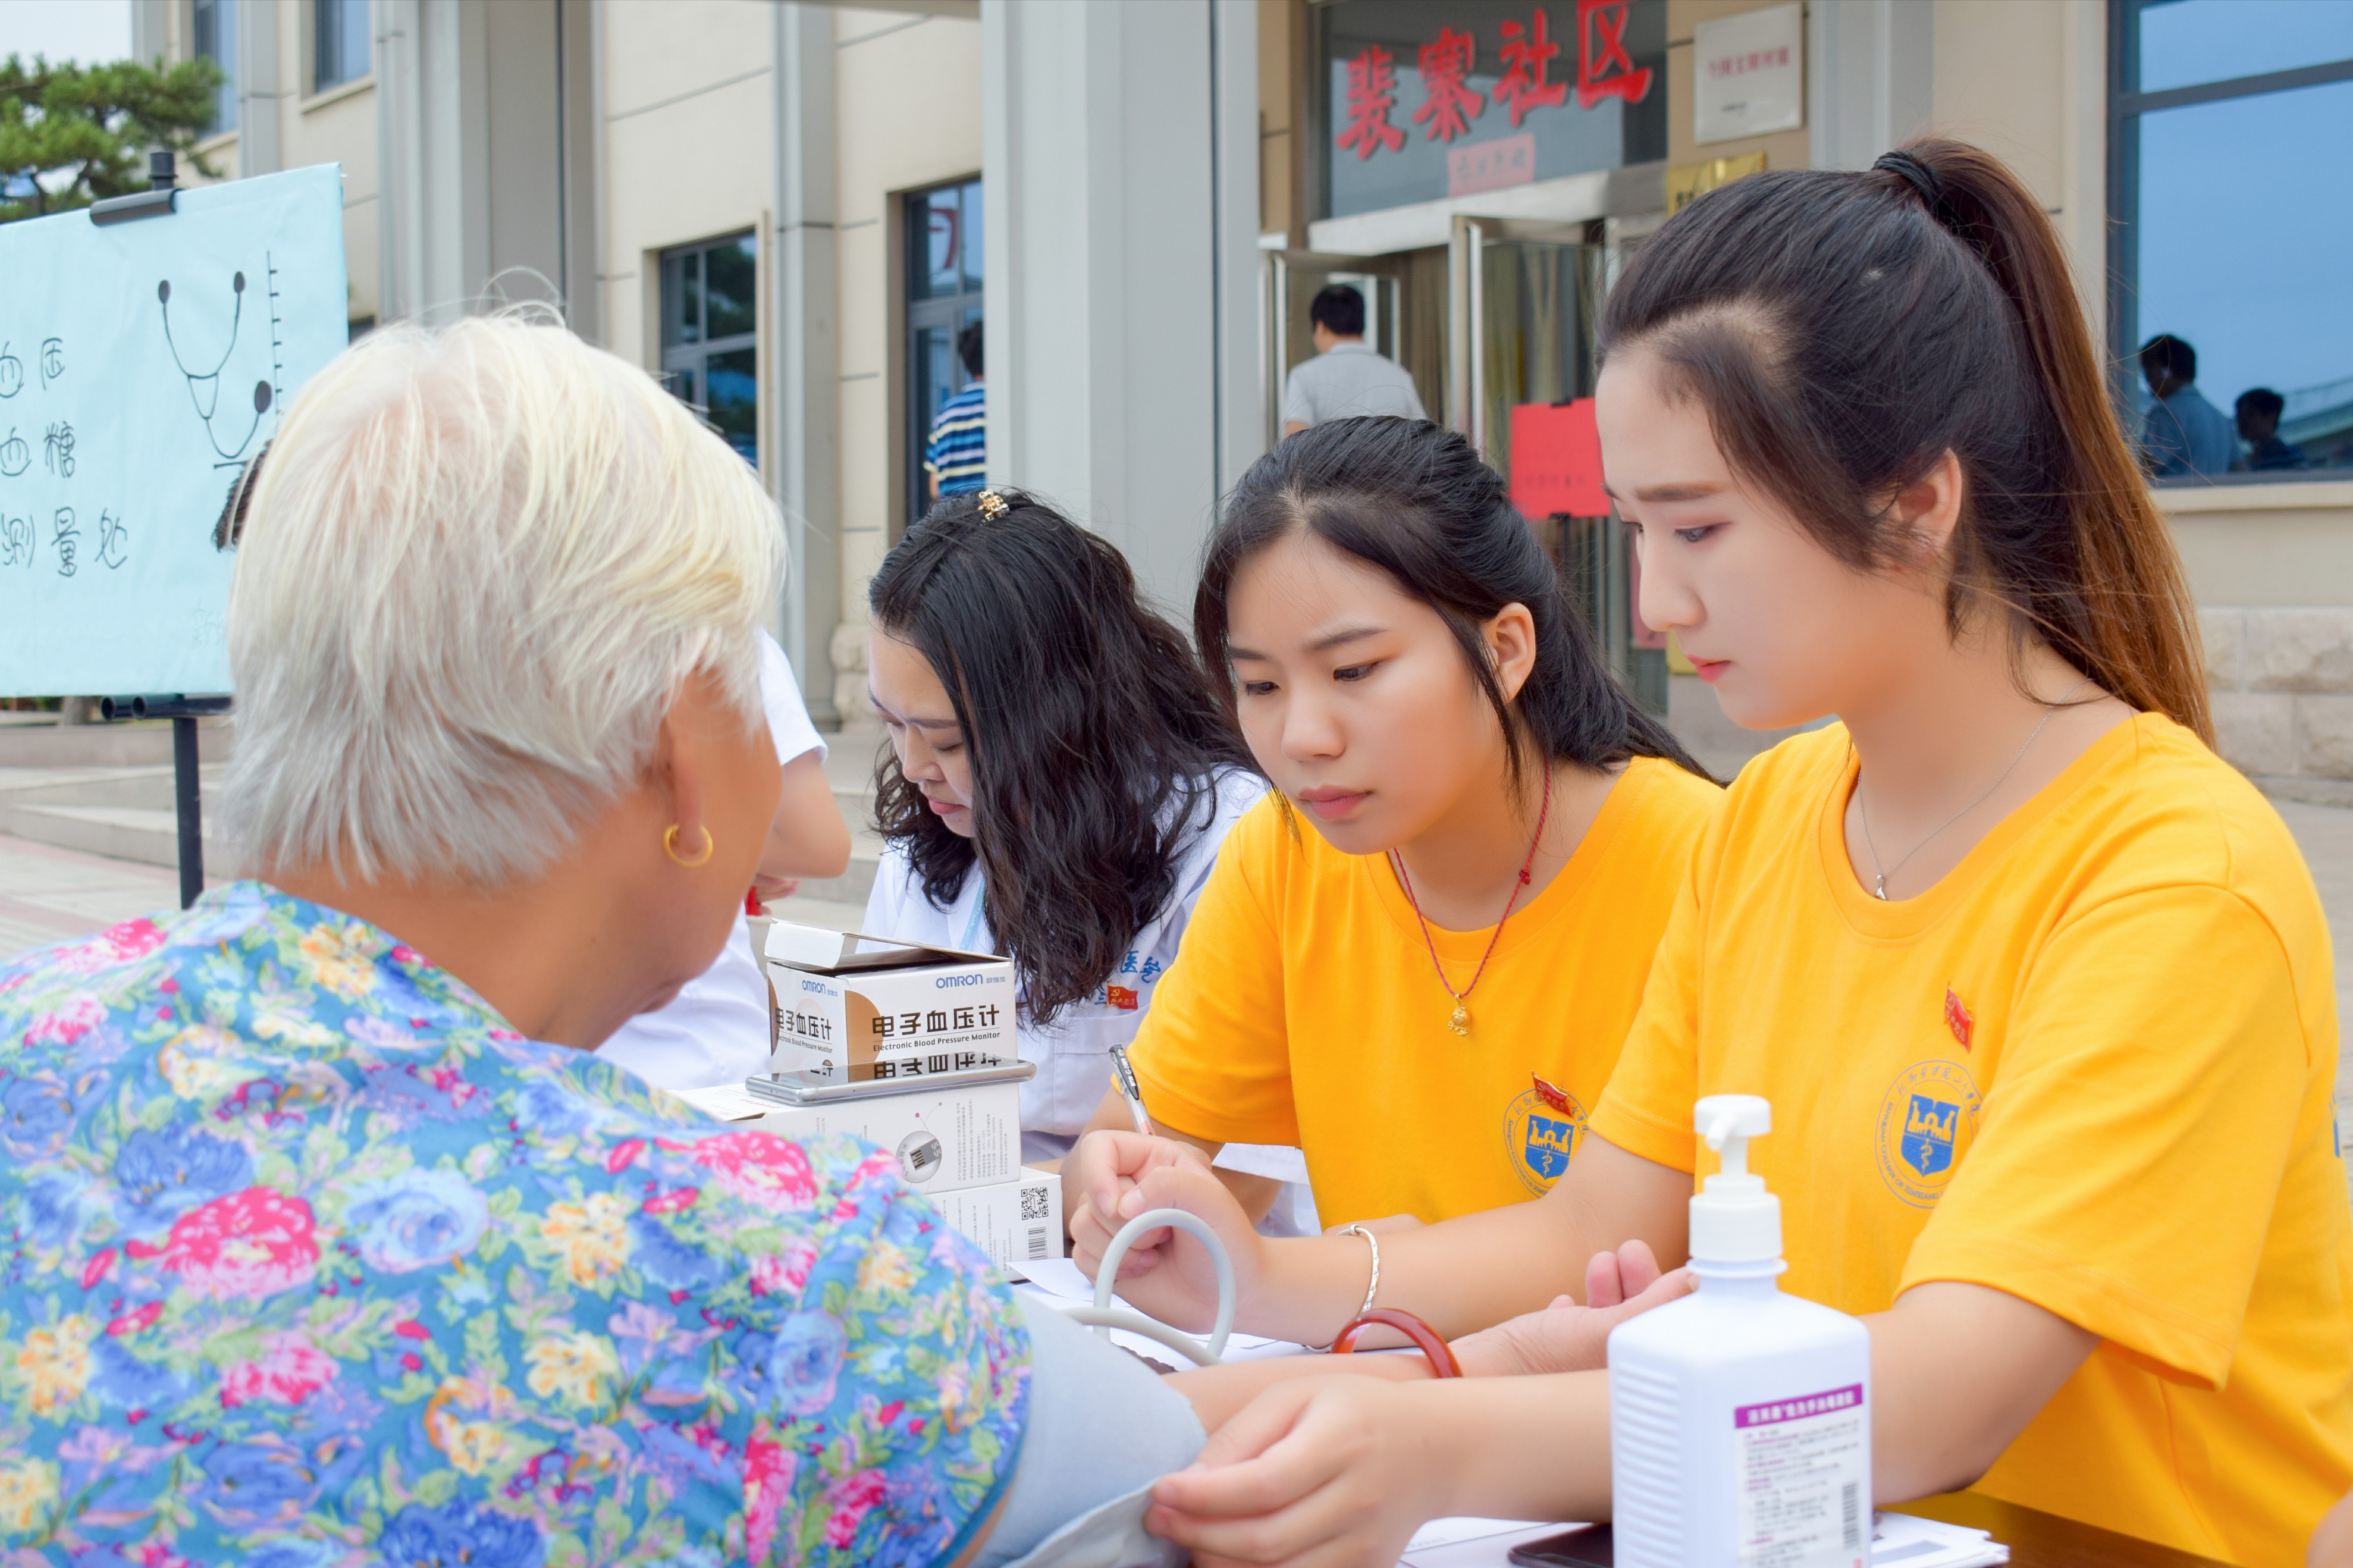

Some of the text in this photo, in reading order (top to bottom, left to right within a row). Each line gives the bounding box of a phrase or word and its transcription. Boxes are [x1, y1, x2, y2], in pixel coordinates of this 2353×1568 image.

[1336, 0, 1652, 160] 裴寨社区
[0, 337, 65, 398] 血压
[0, 420, 76, 479] 血糖
[2, 506, 128, 577] 测量处
[802, 979, 826, 995] OMRON
[936, 973, 1006, 989] OMRON 欧姆龙
[775, 1006, 832, 1041] 电子血压计
[872, 1003, 1000, 1037] 电子血压计
[792, 1037, 802, 1047] Blood
[802, 1039, 817, 1050] Pressure
[817, 1044, 833, 1054] Monitor
[873, 1031, 1001, 1052] Electronic Blood Pressure Monitor
[1538, 1091, 1565, 1111] 共产党员
[1895, 1177, 1904, 1189] OF
